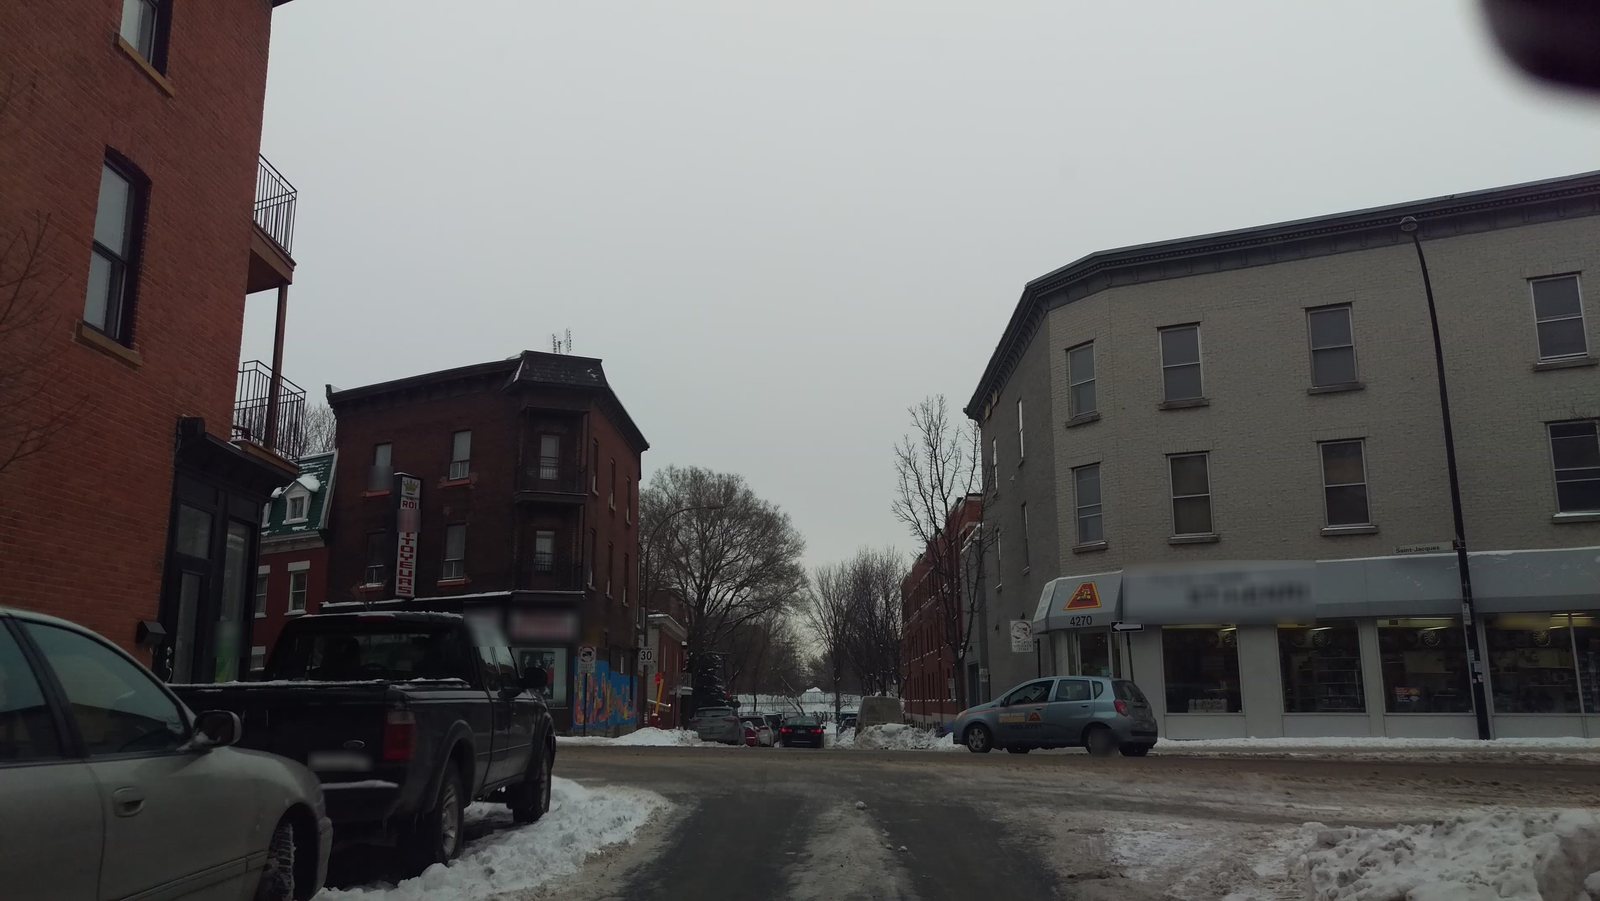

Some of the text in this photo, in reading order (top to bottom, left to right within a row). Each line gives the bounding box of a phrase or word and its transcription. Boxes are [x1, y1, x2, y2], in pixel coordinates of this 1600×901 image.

[401, 500, 417, 510] ROI
[1070, 615, 1093, 626] 4270
[640, 650, 653, 661] 30
